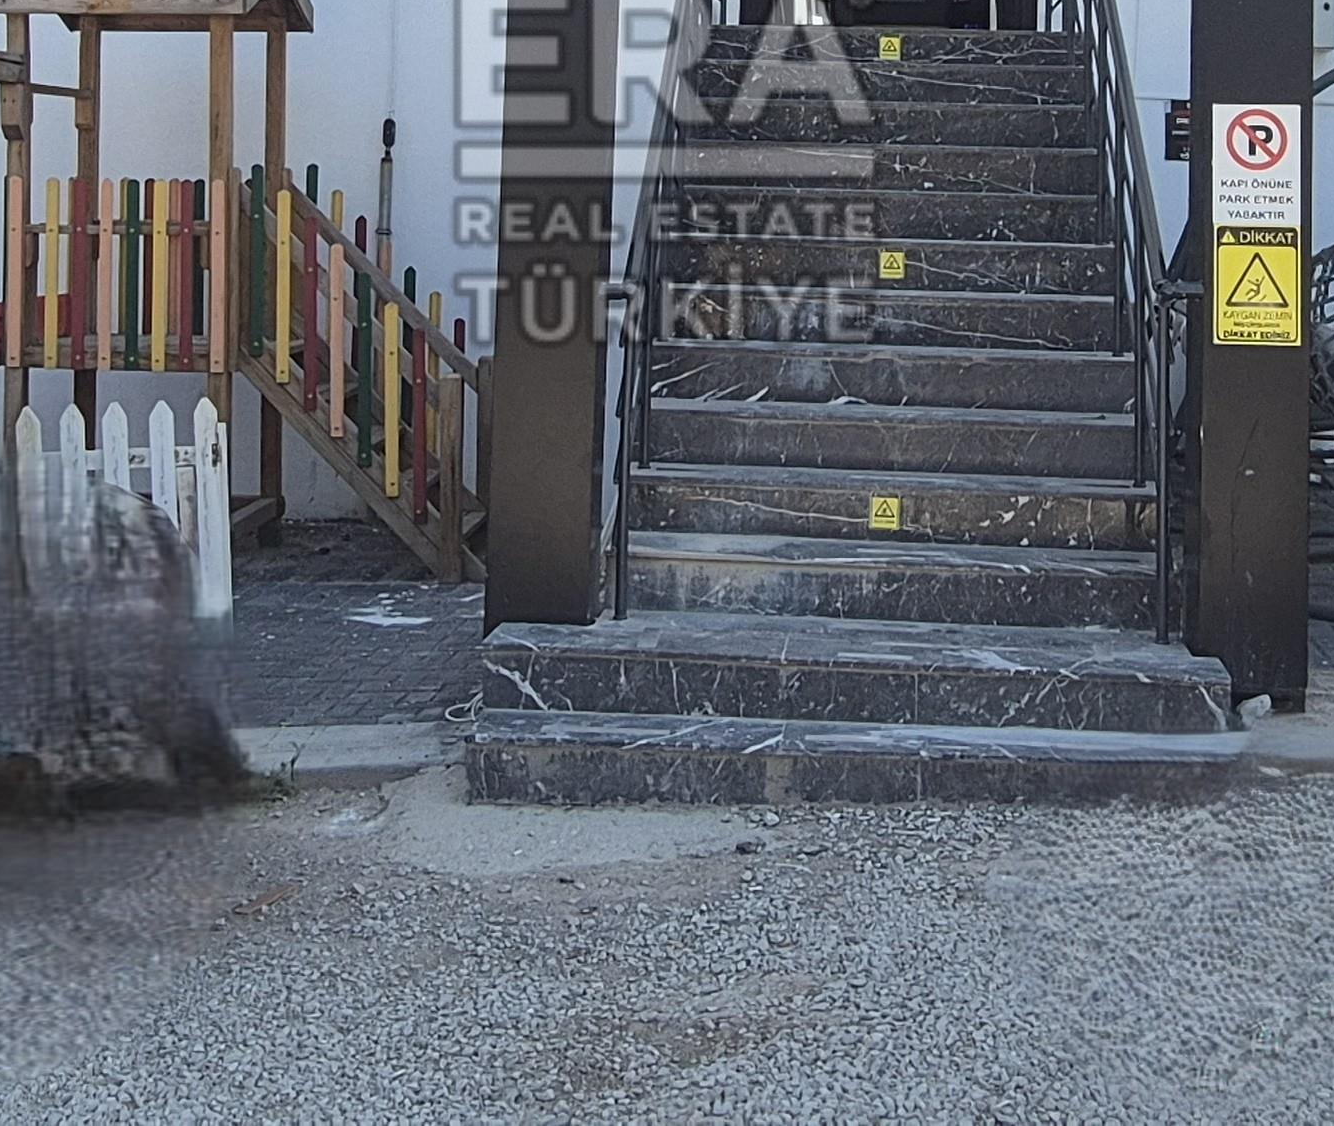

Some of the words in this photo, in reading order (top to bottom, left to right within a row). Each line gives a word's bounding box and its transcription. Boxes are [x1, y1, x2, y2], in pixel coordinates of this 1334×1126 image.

[1220, 179, 1248, 188] KAPI
[1251, 178, 1292, 189] ÖNÜNE
[1219, 194, 1250, 204] PARK
[1254, 195, 1294, 204] ETMEK
[1228, 210, 1285, 220] YASAKTIR
[1239, 229, 1294, 244] DİKKAT
